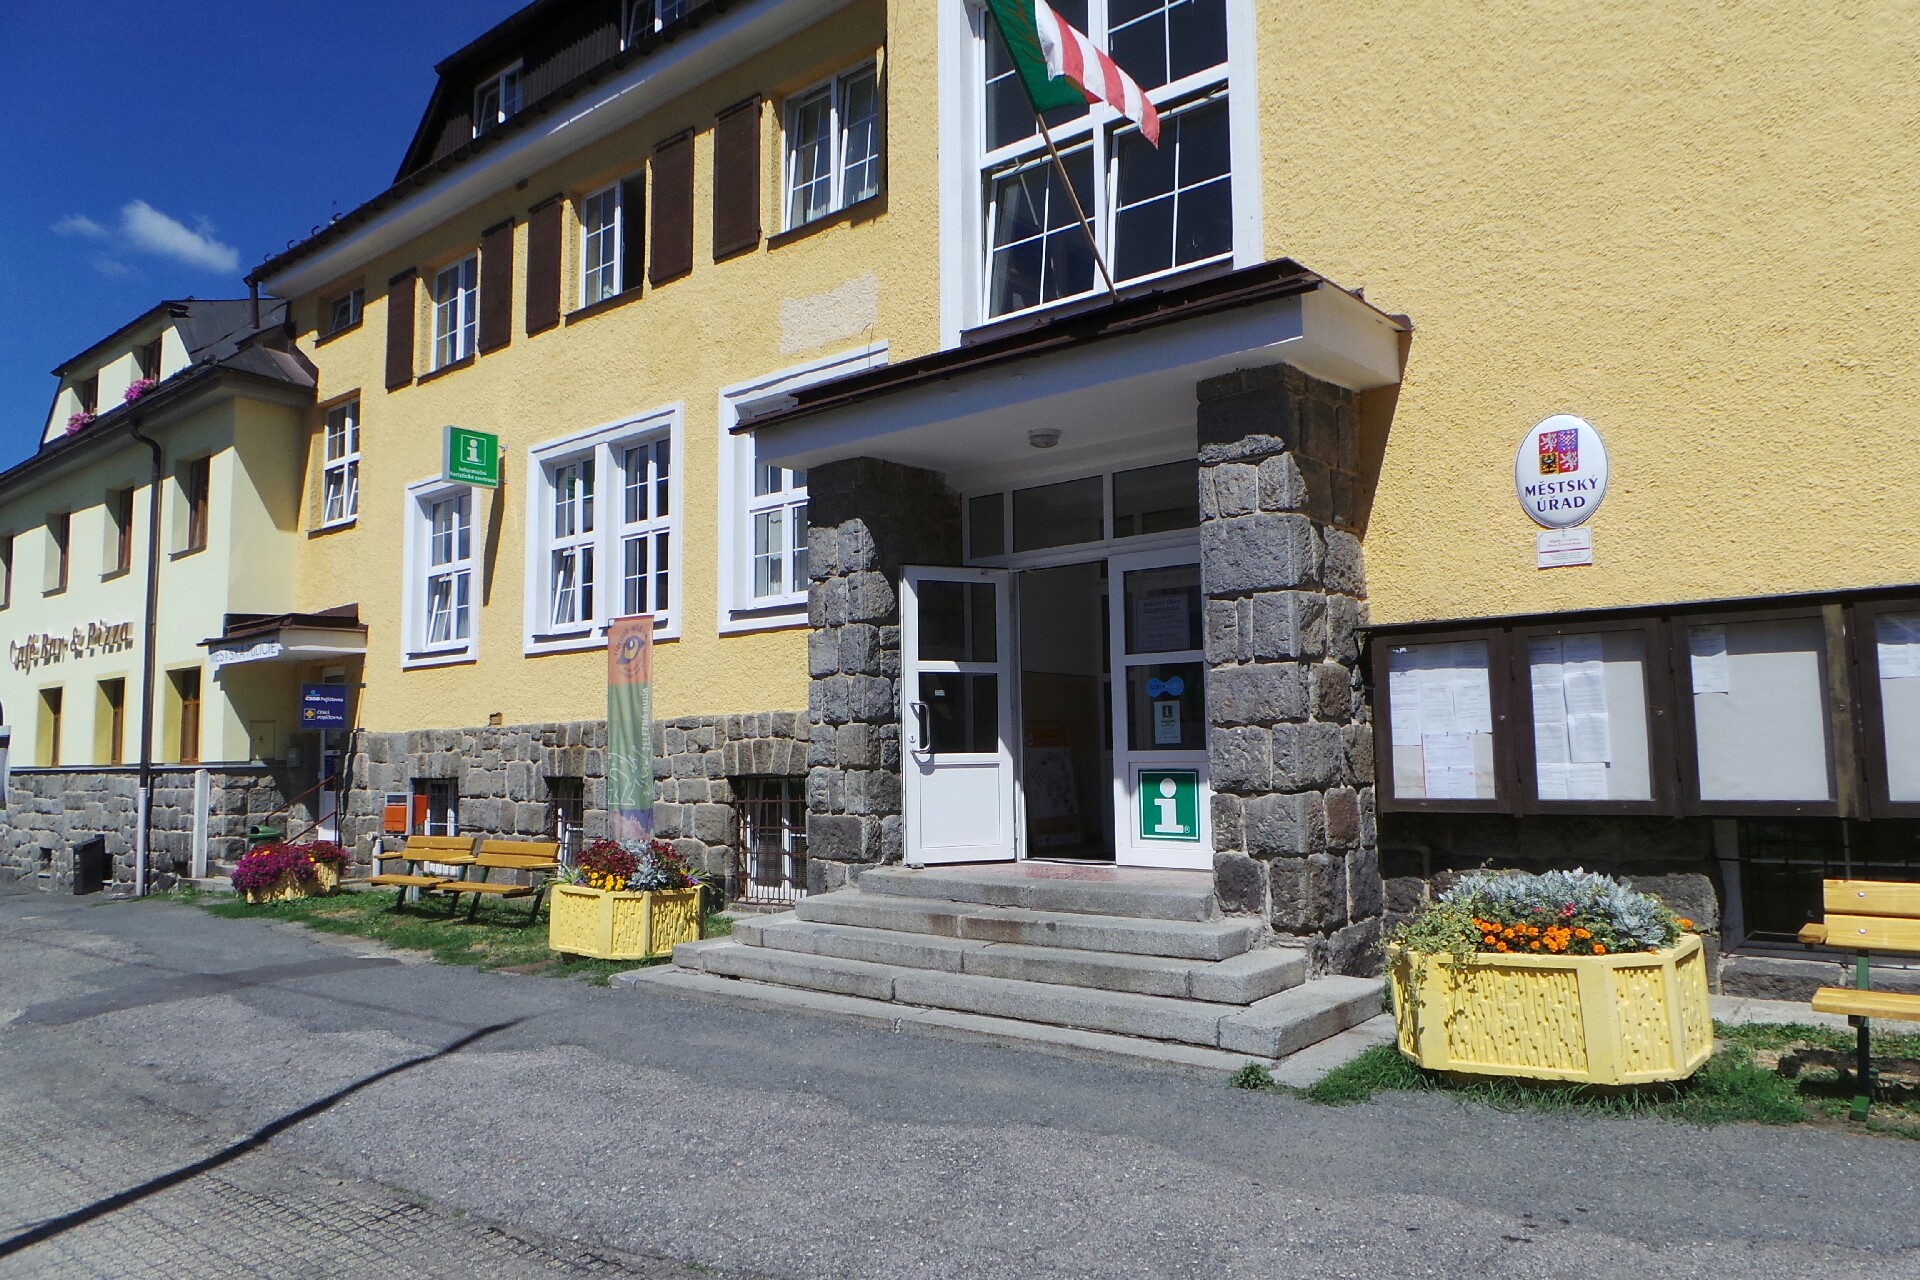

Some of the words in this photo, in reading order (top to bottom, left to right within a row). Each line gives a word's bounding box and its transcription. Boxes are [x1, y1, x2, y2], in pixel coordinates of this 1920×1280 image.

[1525, 474, 1598, 497] MĚSTSKÝ
[1537, 495, 1586, 512] ÚŘAD
[10, 633, 38, 673] Café
[40, 633, 67, 661] Bar
[70, 626, 84, 657] &
[86, 619, 133, 654] Pizza
